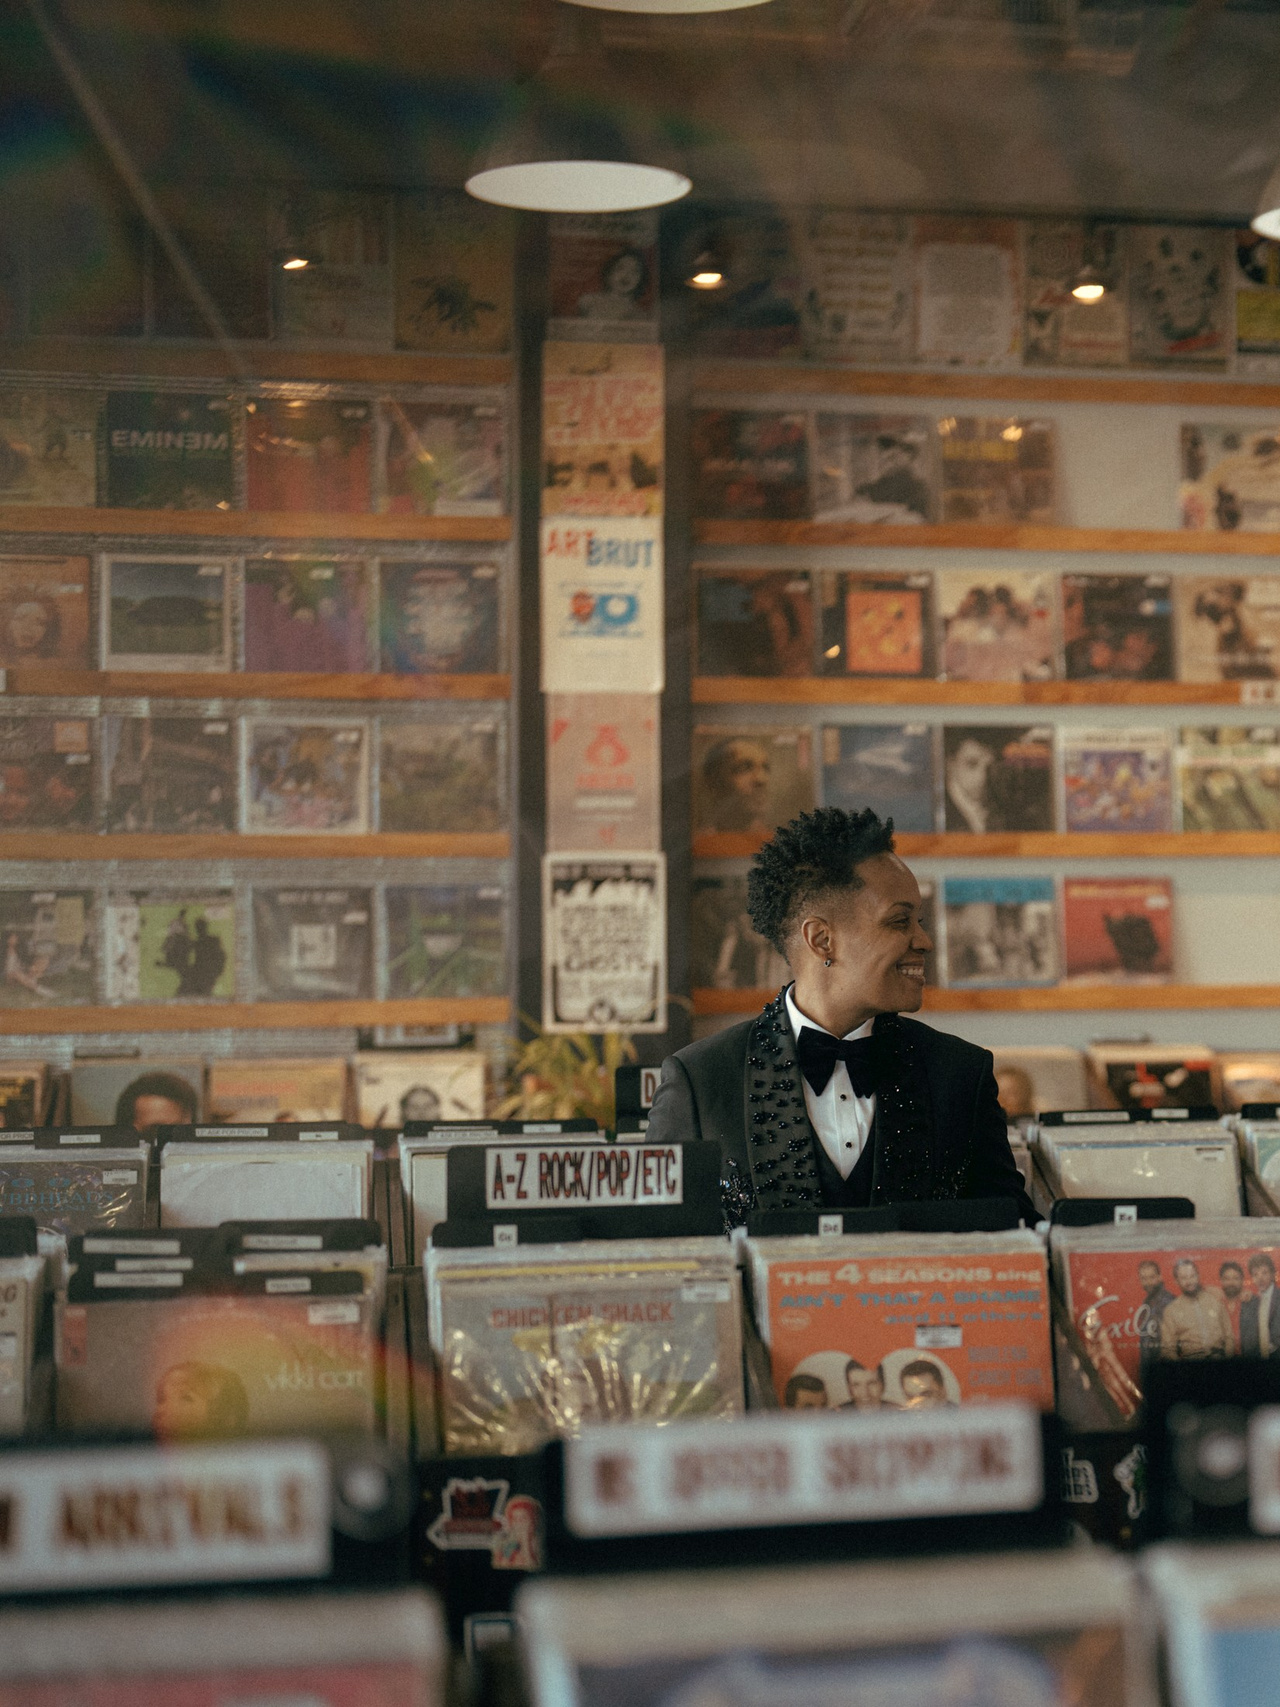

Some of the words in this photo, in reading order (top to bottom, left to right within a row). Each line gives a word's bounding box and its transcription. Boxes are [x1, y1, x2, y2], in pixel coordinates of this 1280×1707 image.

[547, 530, 594, 556] ART
[586, 540, 655, 567] BRUT
[645, 1074, 656, 1097] D
[494, 1154, 527, 1199] A-Z
[540, 1149, 676, 1200] ROCK/POP/ETC
[777, 1270, 830, 1286] THE
[835, 1263, 863, 1285] 4
[868, 1268, 992, 1284] SEASONS
[780, 1292, 846, 1307] AIN'T
[856, 1292, 924, 1307] THAT
[929, 1292, 946, 1305] A
[954, 1290, 1041, 1304] SHAME
[492, 1304, 591, 1329] CHICKEN
[602, 1302, 674, 1324] SHACK
[885, 1312, 929, 1323] and
[1079, 1296, 1159, 1341] Exile
